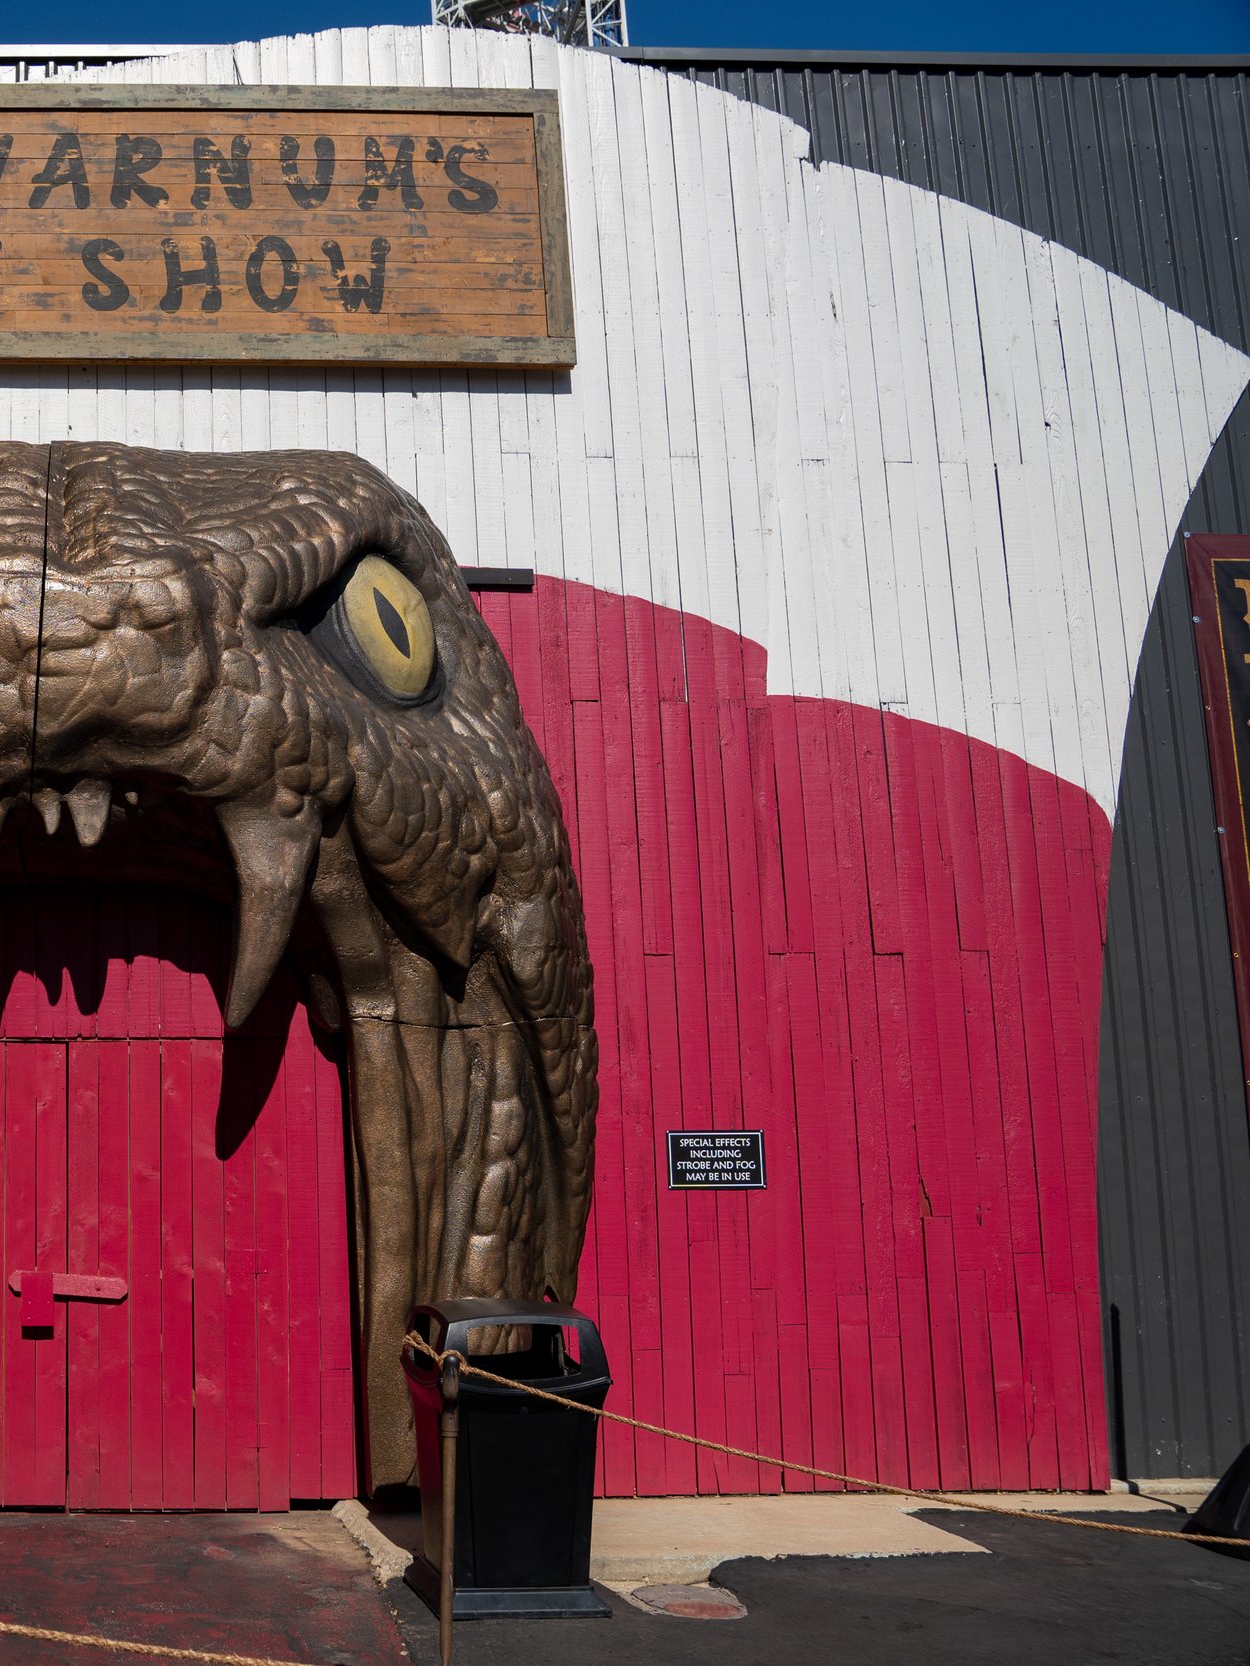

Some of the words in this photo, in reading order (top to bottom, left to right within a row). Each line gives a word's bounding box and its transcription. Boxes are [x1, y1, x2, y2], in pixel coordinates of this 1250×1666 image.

[82, 236, 391, 314] SHOW
[679, 1138, 713, 1147] SPECIAL
[715, 1138, 751, 1147] EFFECTS
[690, 1149, 742, 1158] INCLUDING
[676, 1161, 711, 1170] STROBE
[712, 1161, 734, 1169] AND
[736, 1160, 756, 1169] FOG
[686, 1172, 707, 1181] MAY
[708, 1172, 720, 1181] BE
[721, 1172, 732, 1180] IN
[734, 1172, 751, 1180] USE
